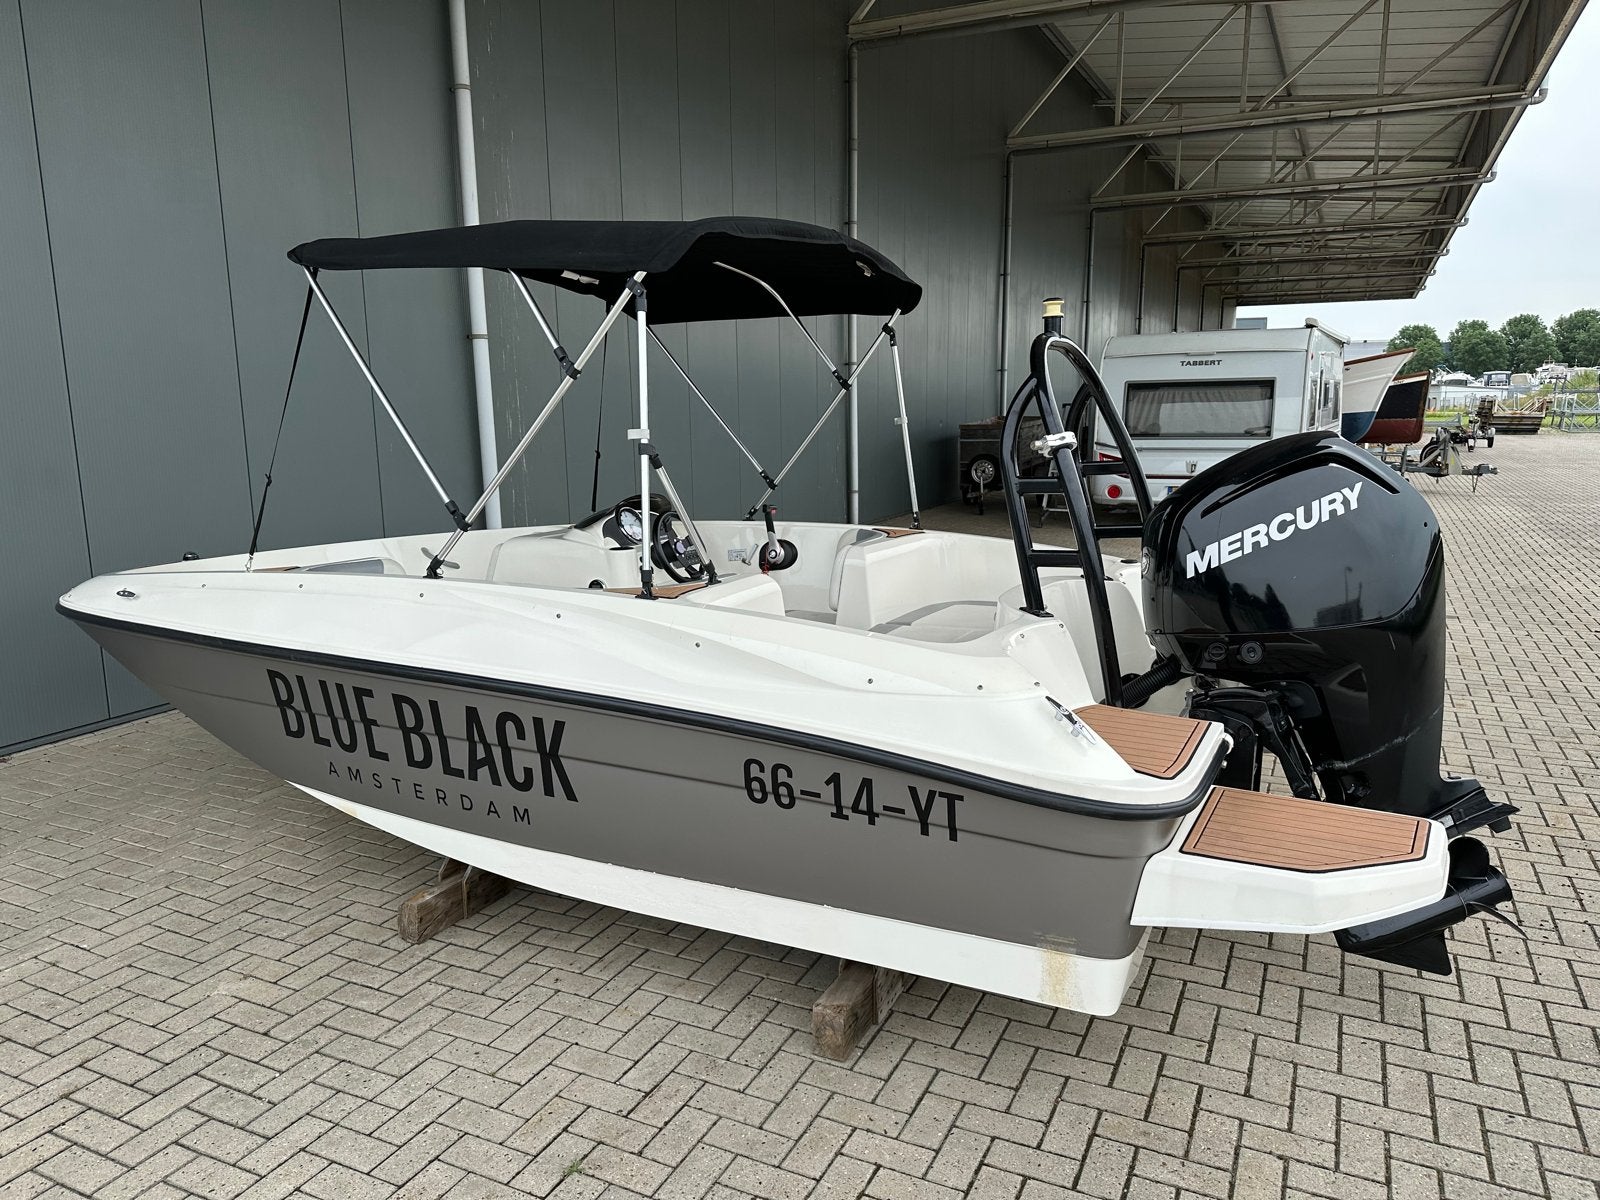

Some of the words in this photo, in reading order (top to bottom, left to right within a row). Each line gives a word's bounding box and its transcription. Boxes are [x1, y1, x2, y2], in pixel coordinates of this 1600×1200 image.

[1186, 481, 1363, 579] MERCURY
[266, 668, 390, 762] BLUE
[391, 692, 579, 803] BLACK
[328, 760, 532, 825] AMSTERDAM
[743, 758, 965, 843] 66-14-YT
